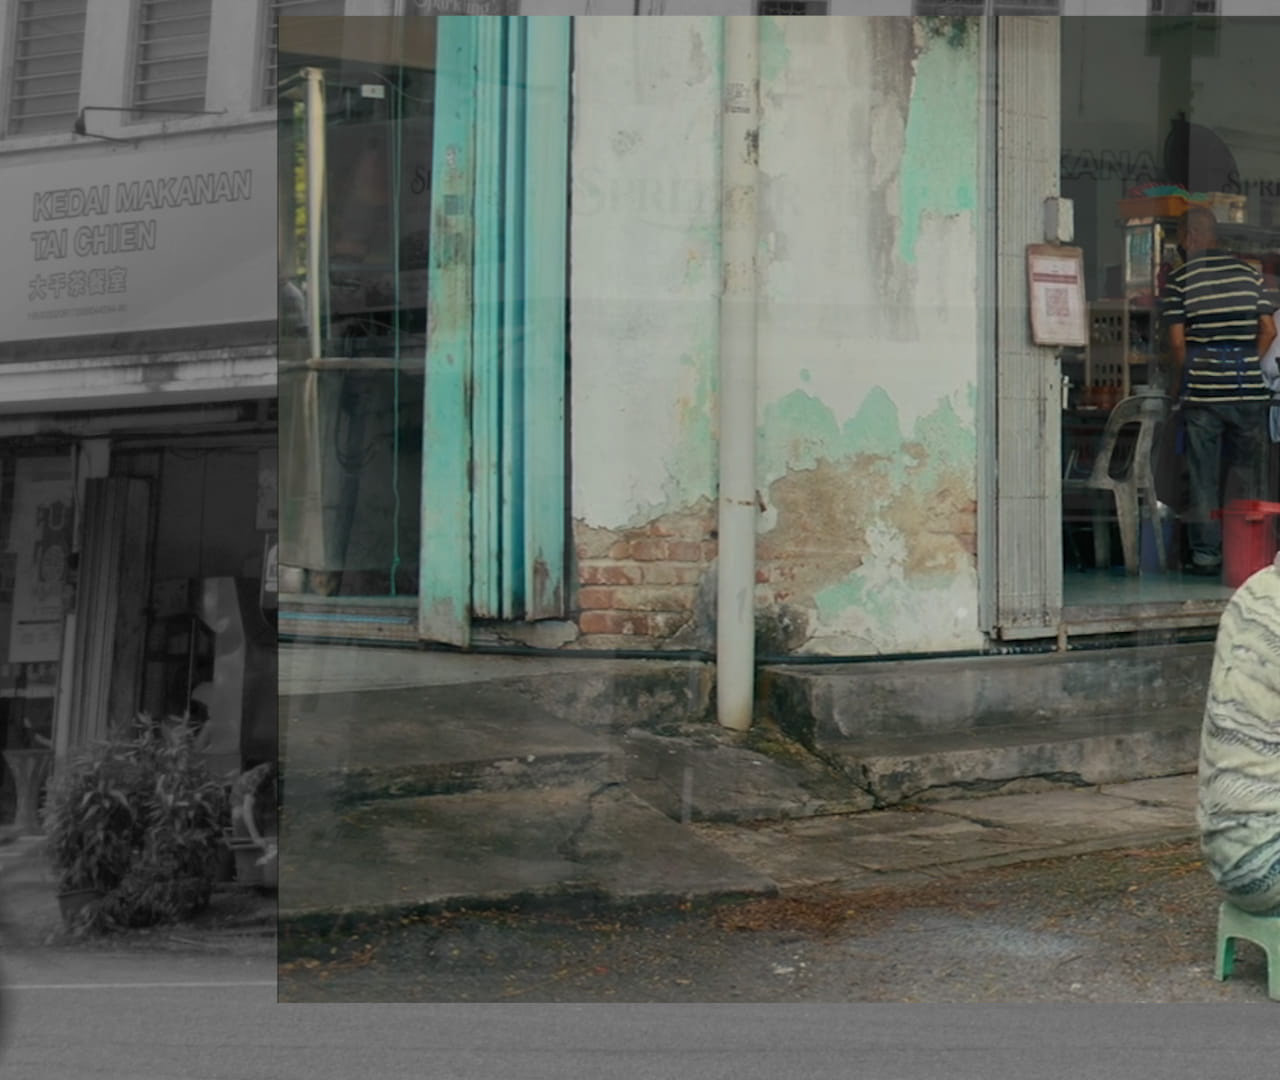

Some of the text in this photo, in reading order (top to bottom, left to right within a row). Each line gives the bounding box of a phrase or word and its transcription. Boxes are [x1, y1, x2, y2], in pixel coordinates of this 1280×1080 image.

[32, 169, 253, 222] KEDAI MAKANAN
[30, 219, 157, 262] TAI CHIEN
